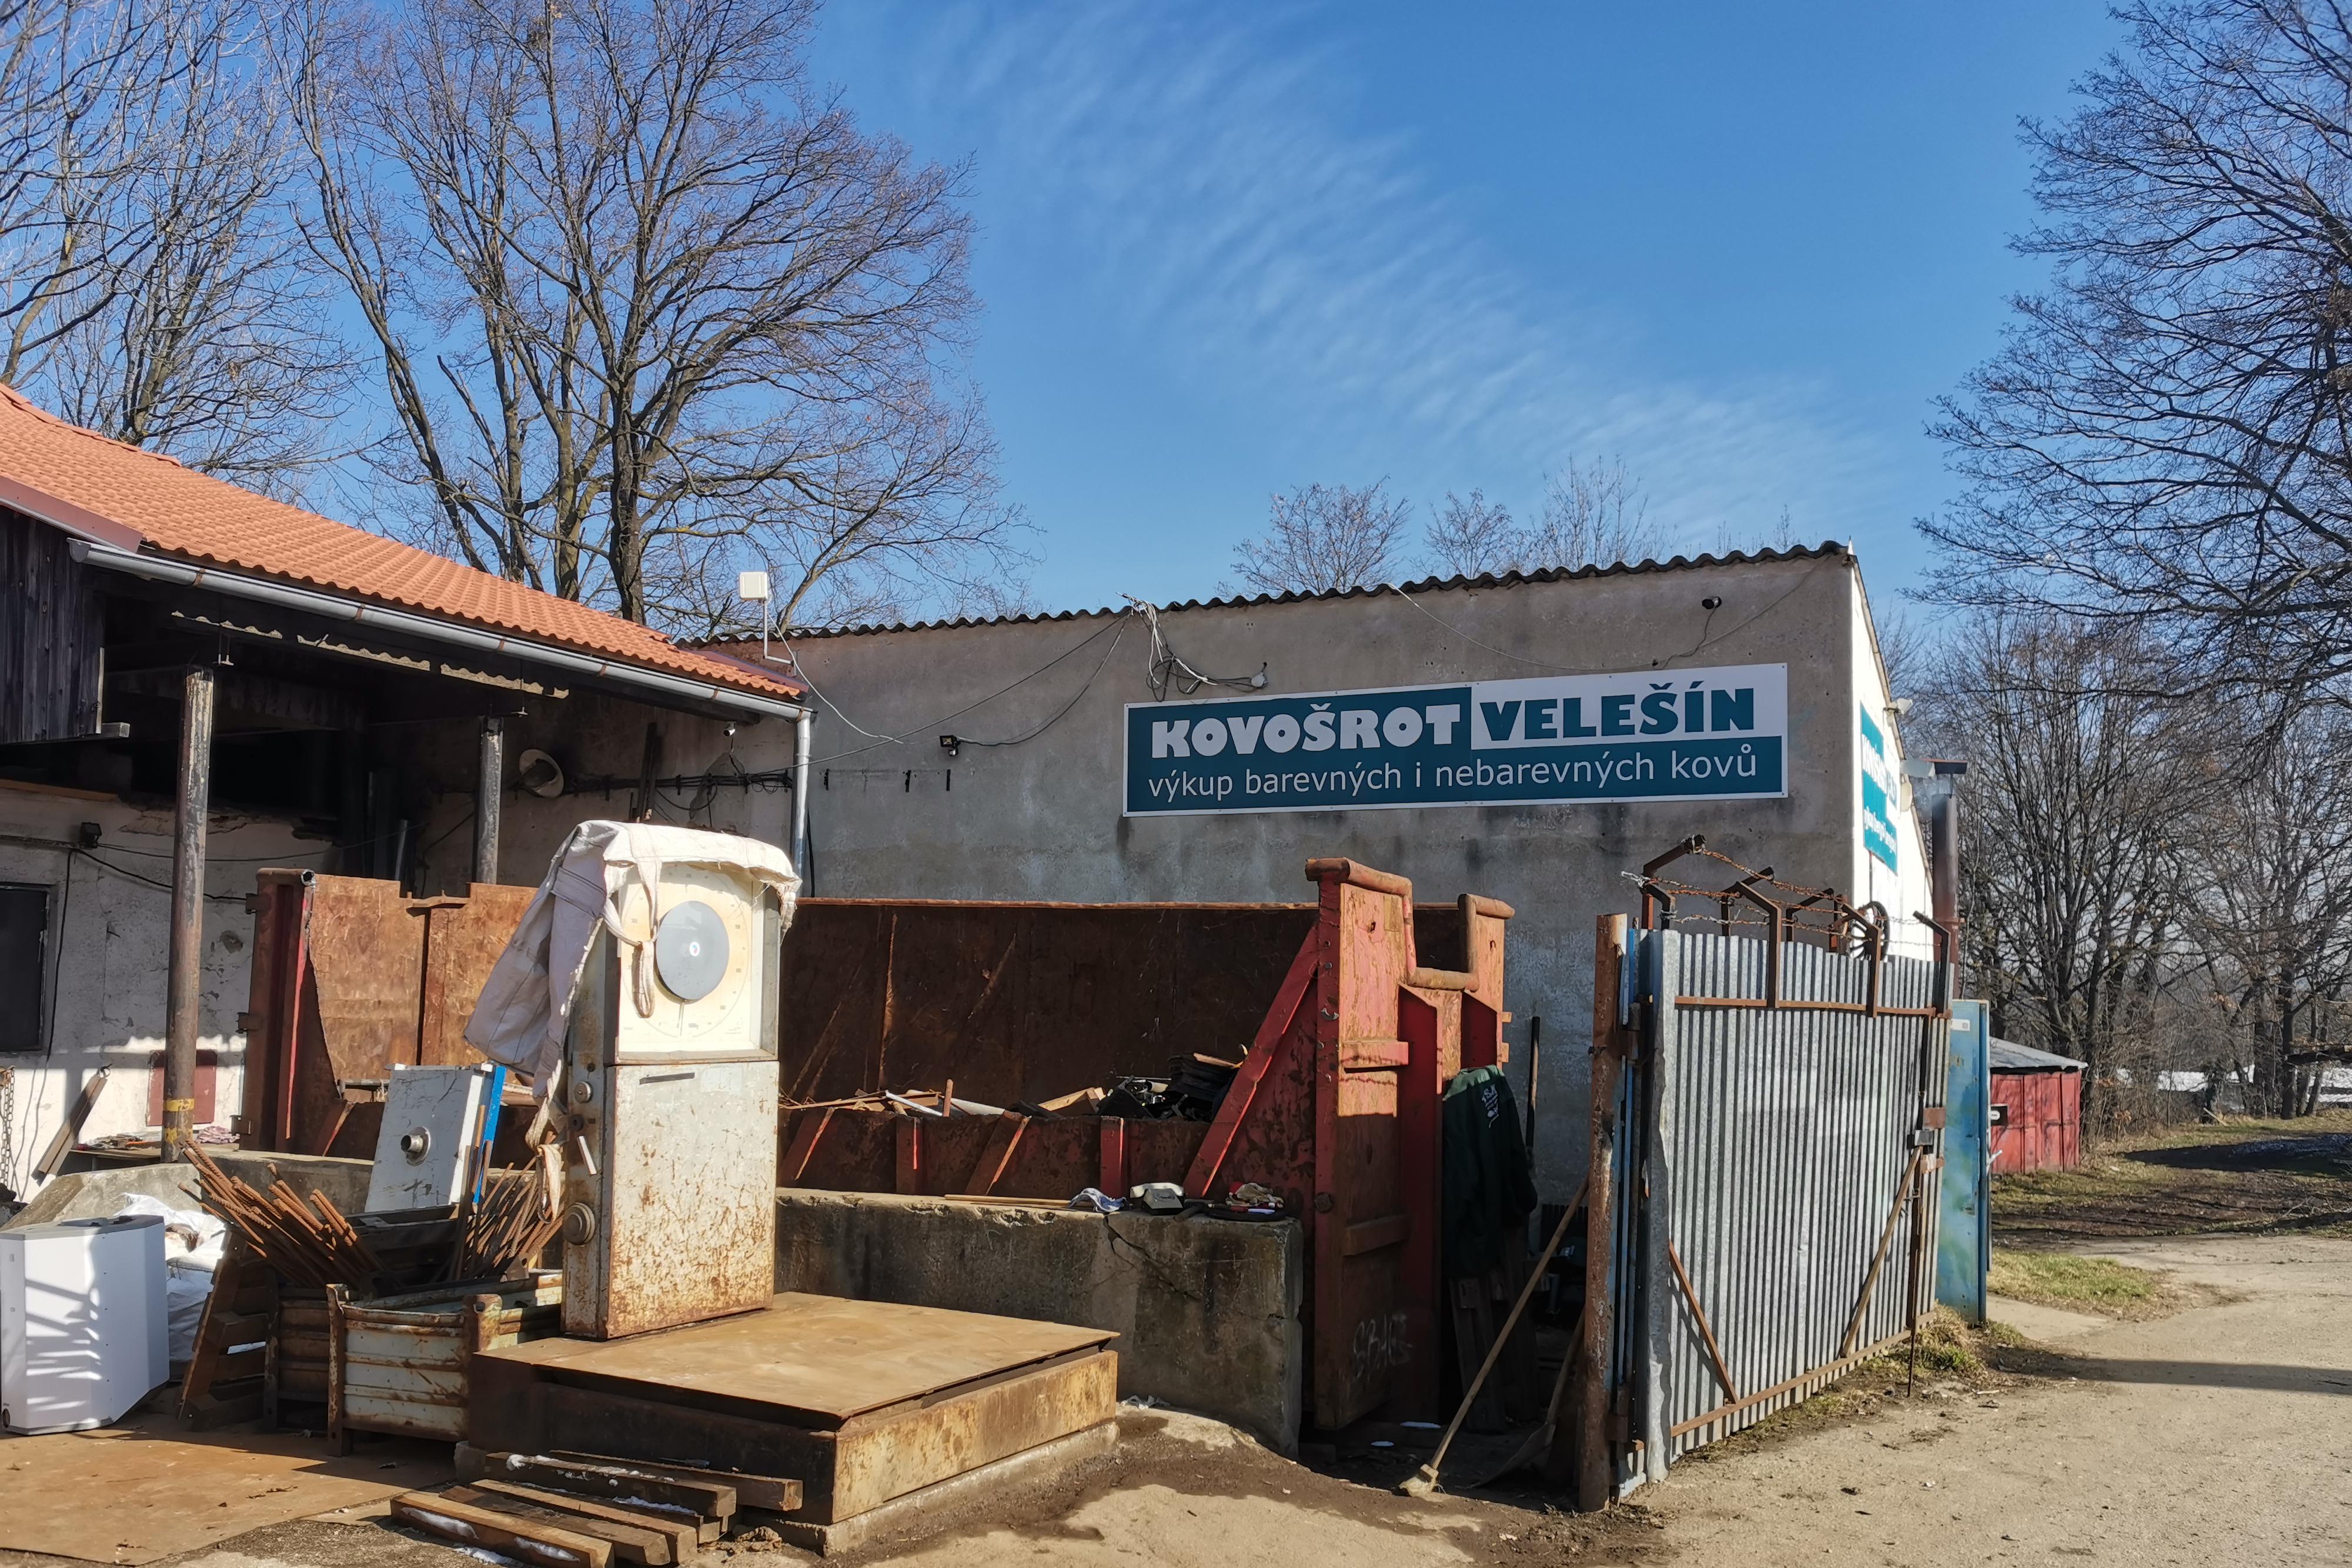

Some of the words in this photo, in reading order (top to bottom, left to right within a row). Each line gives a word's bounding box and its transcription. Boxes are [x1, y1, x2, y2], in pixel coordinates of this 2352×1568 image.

[1152, 703, 1461, 758] KOVOŠROT
[1479, 681, 1754, 741] VELEŠÍN
[1148, 770, 1232, 803] výkup
[1246, 762, 1401, 796] barevných
[1416, 761, 1421, 788] i
[1435, 751, 1654, 788] nebarevných
[1672, 743, 1756, 779] kovů
